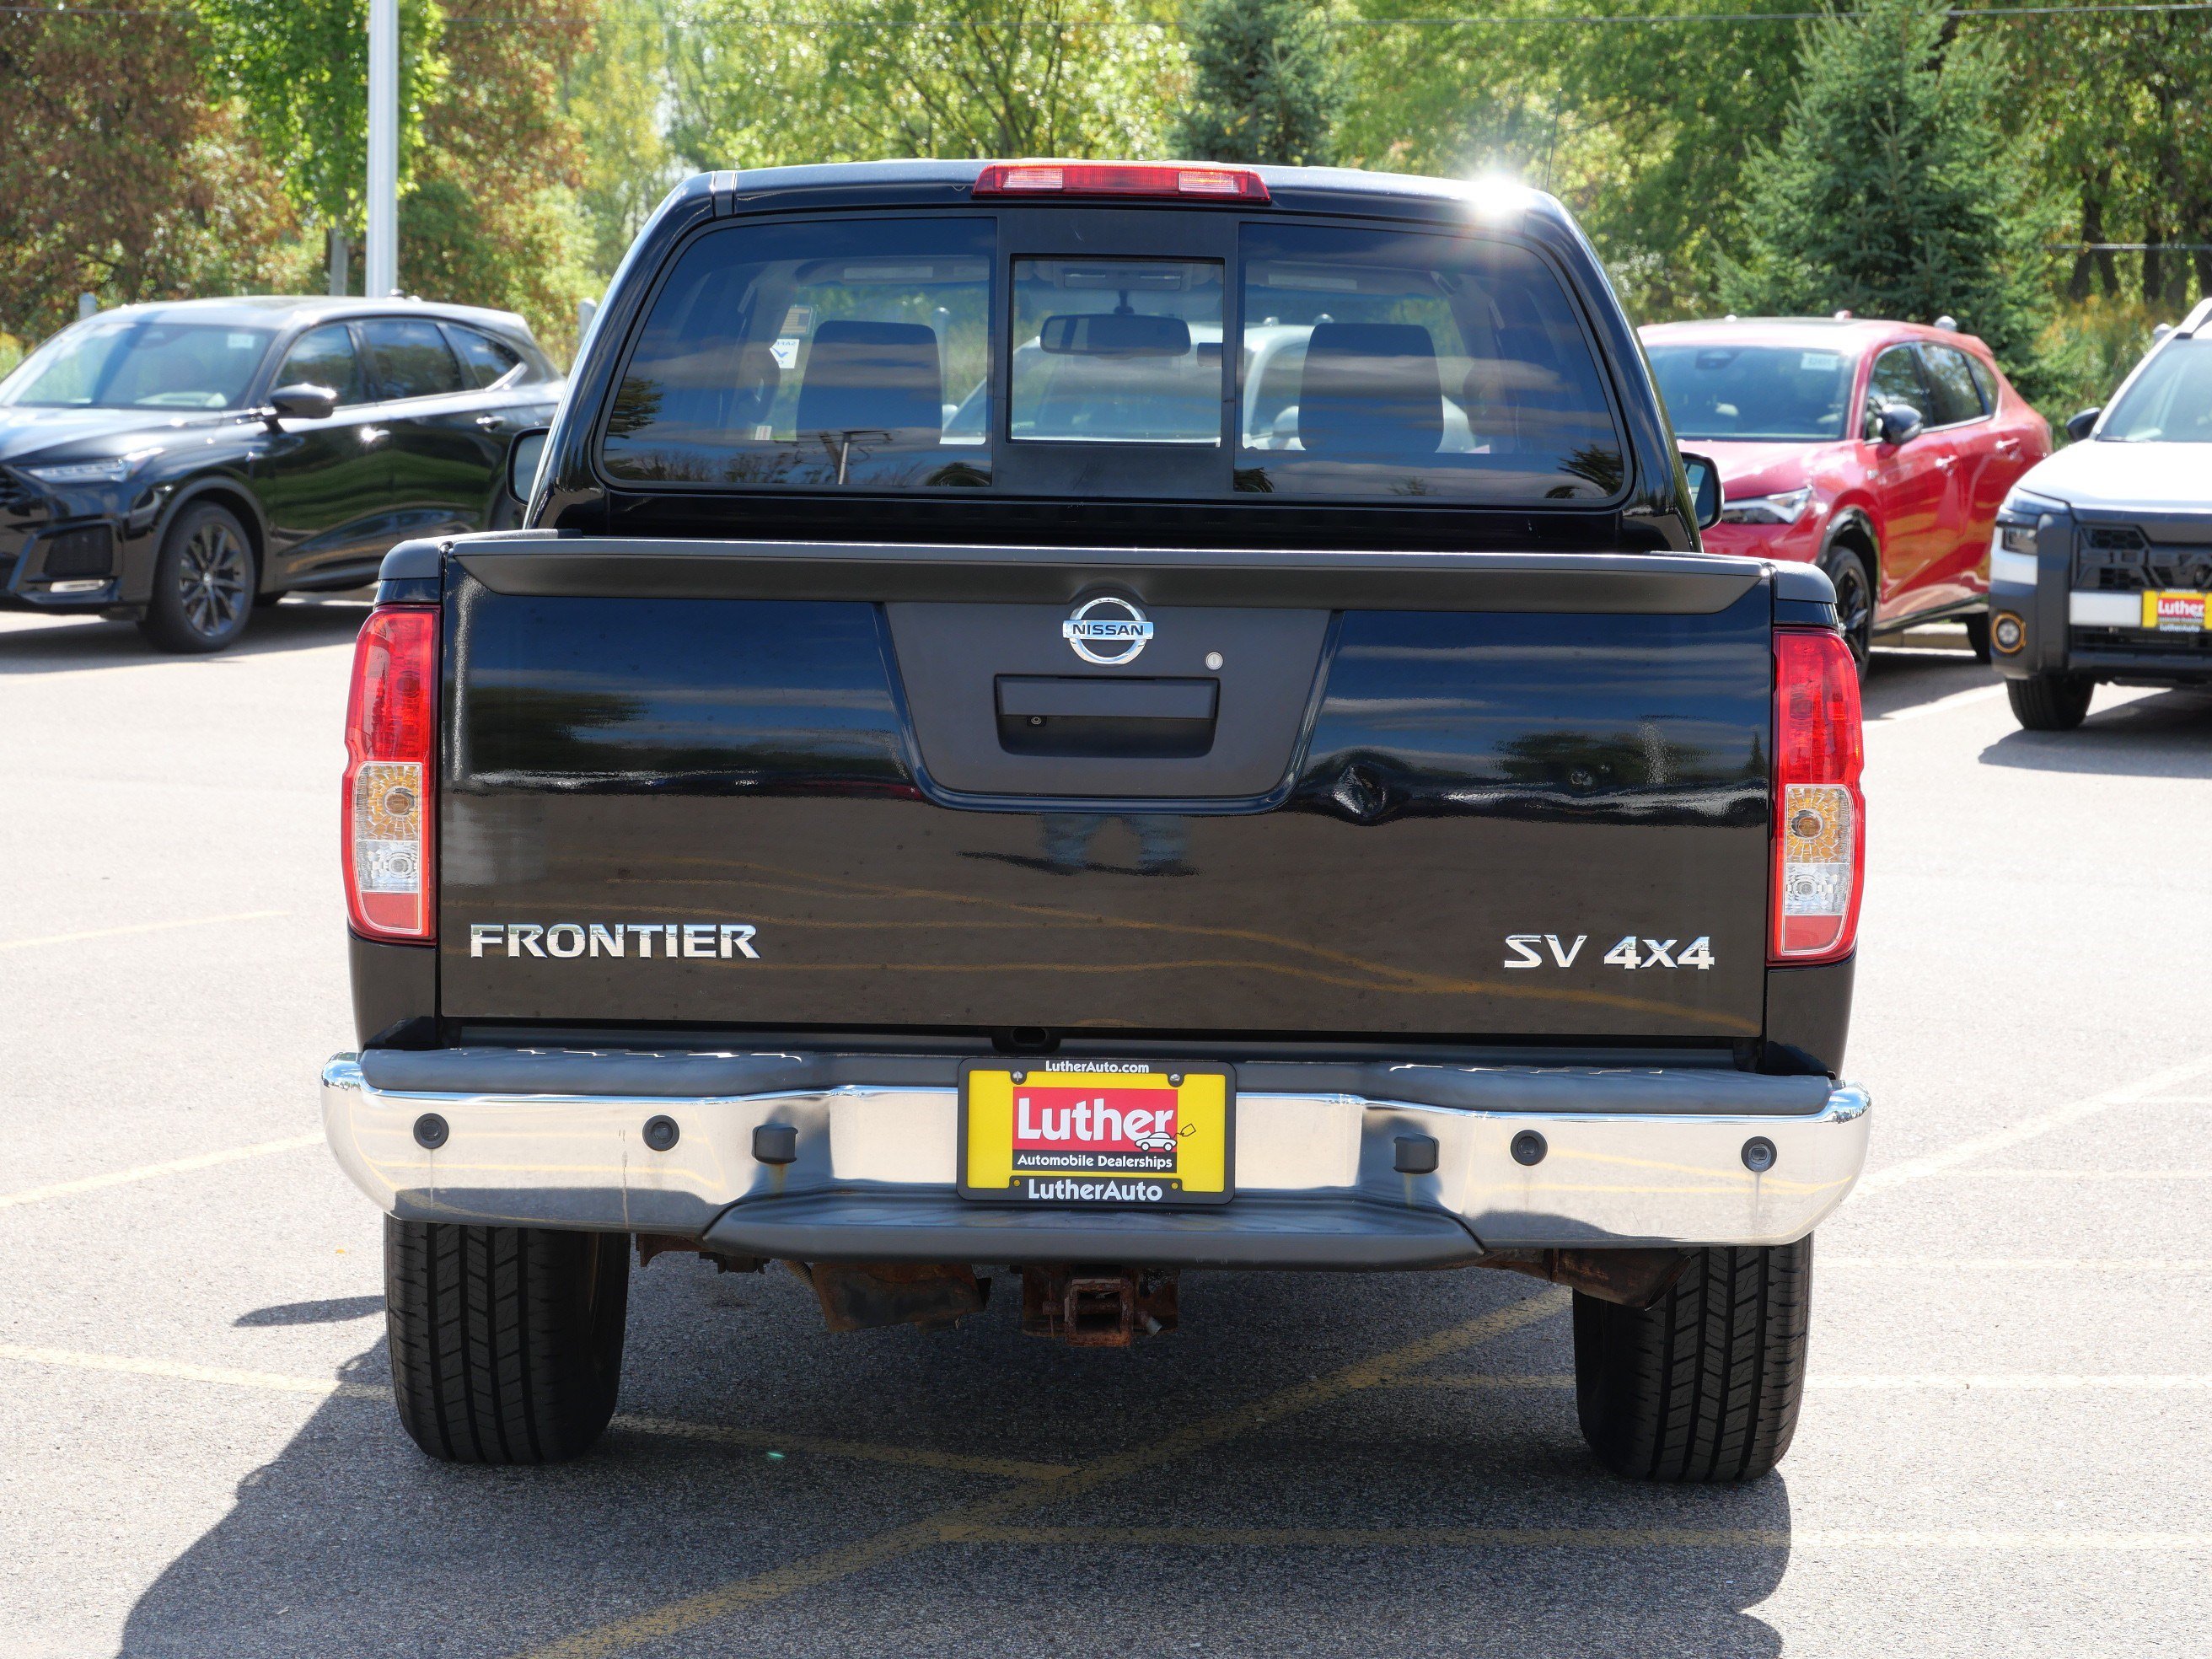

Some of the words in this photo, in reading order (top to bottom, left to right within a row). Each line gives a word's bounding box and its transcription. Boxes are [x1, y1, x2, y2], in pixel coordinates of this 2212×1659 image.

[2158, 599, 2205, 616] Luther
[1072, 624, 1144, 636] NISSAN
[470, 923, 760, 958] FRONTIER
[1504, 934, 1588, 969] SV
[1603, 936, 1715, 970] 4x4
[1044, 1060, 1149, 1074] LutherAuto.com
[1017, 1098, 1174, 1142] Luther
[1017, 1153, 1094, 1168] Automobile
[1097, 1154, 1173, 1170] Dealerships
[1028, 1178, 1163, 1202] LutherAuto
